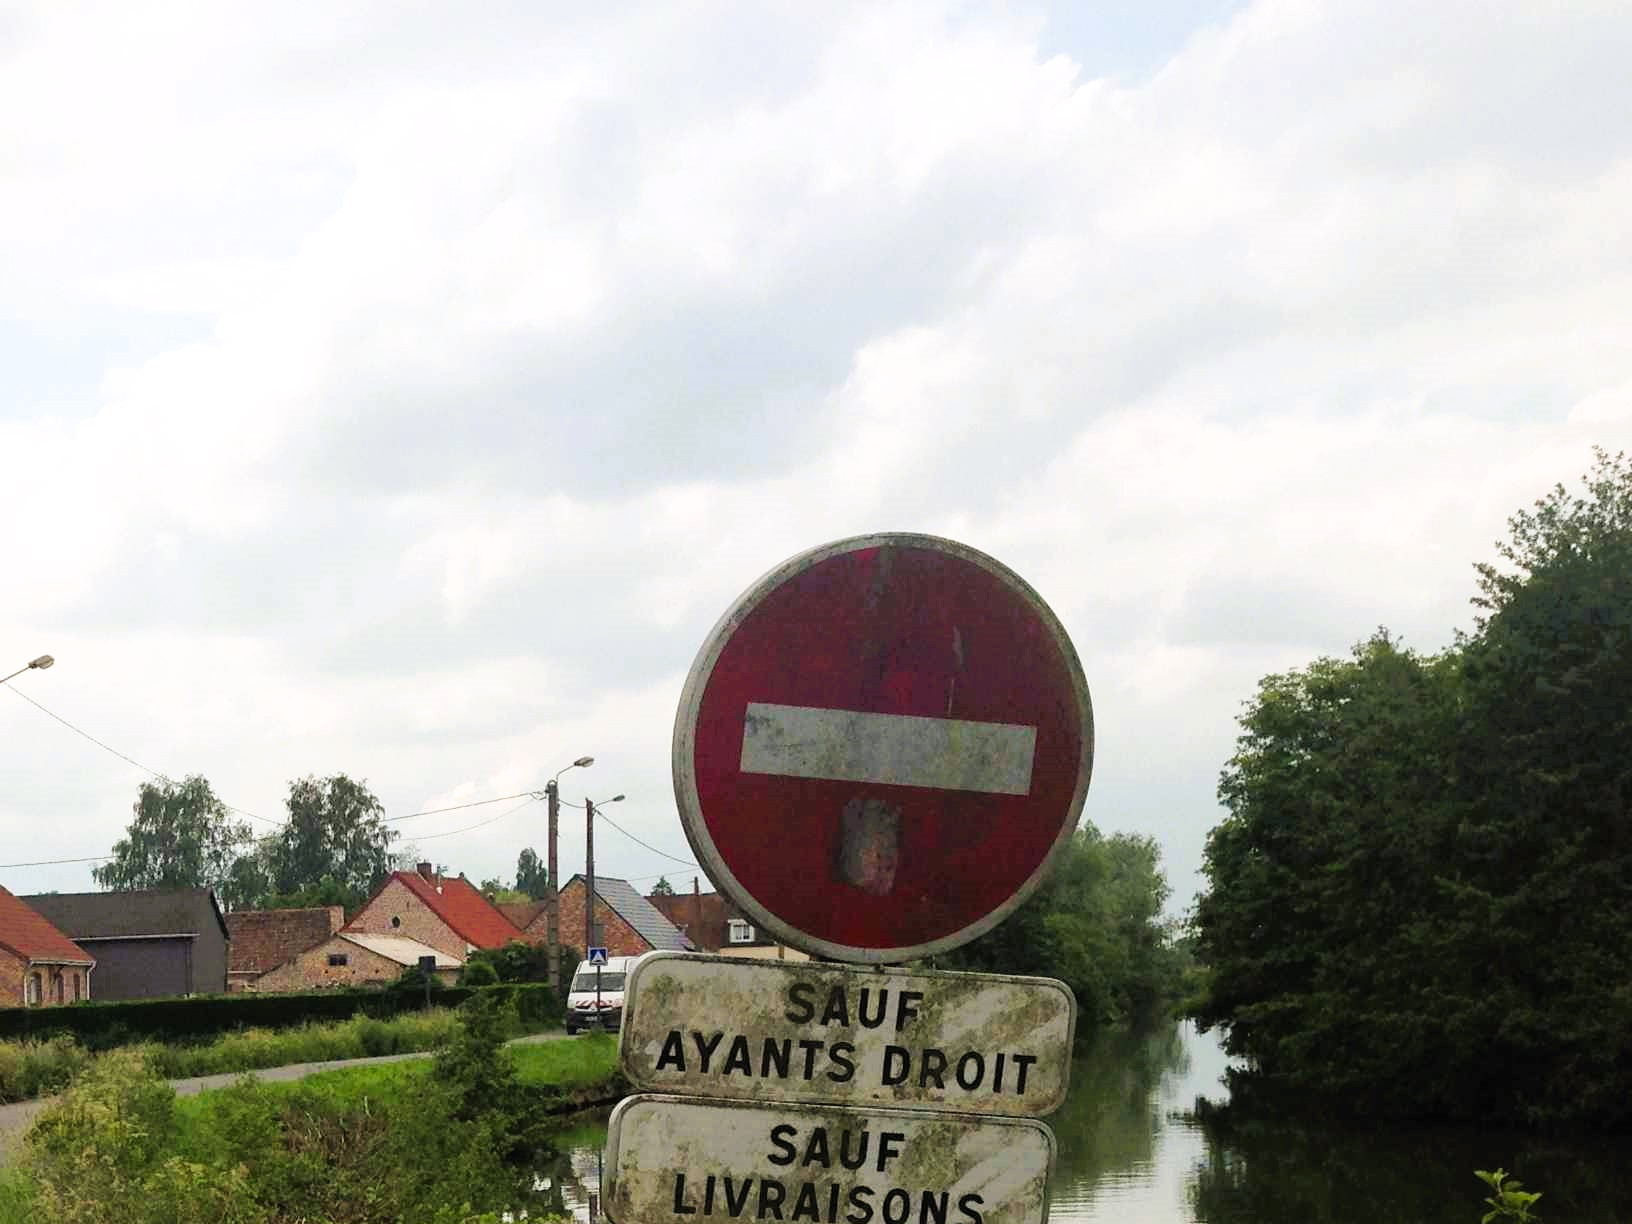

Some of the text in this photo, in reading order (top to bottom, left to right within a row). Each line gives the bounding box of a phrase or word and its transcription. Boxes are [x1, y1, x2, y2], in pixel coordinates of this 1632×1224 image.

[785, 983, 924, 1032] SAUF
[655, 1031, 1037, 1094] AYANTS DROIT
[767, 1124, 905, 1171] SAUF
